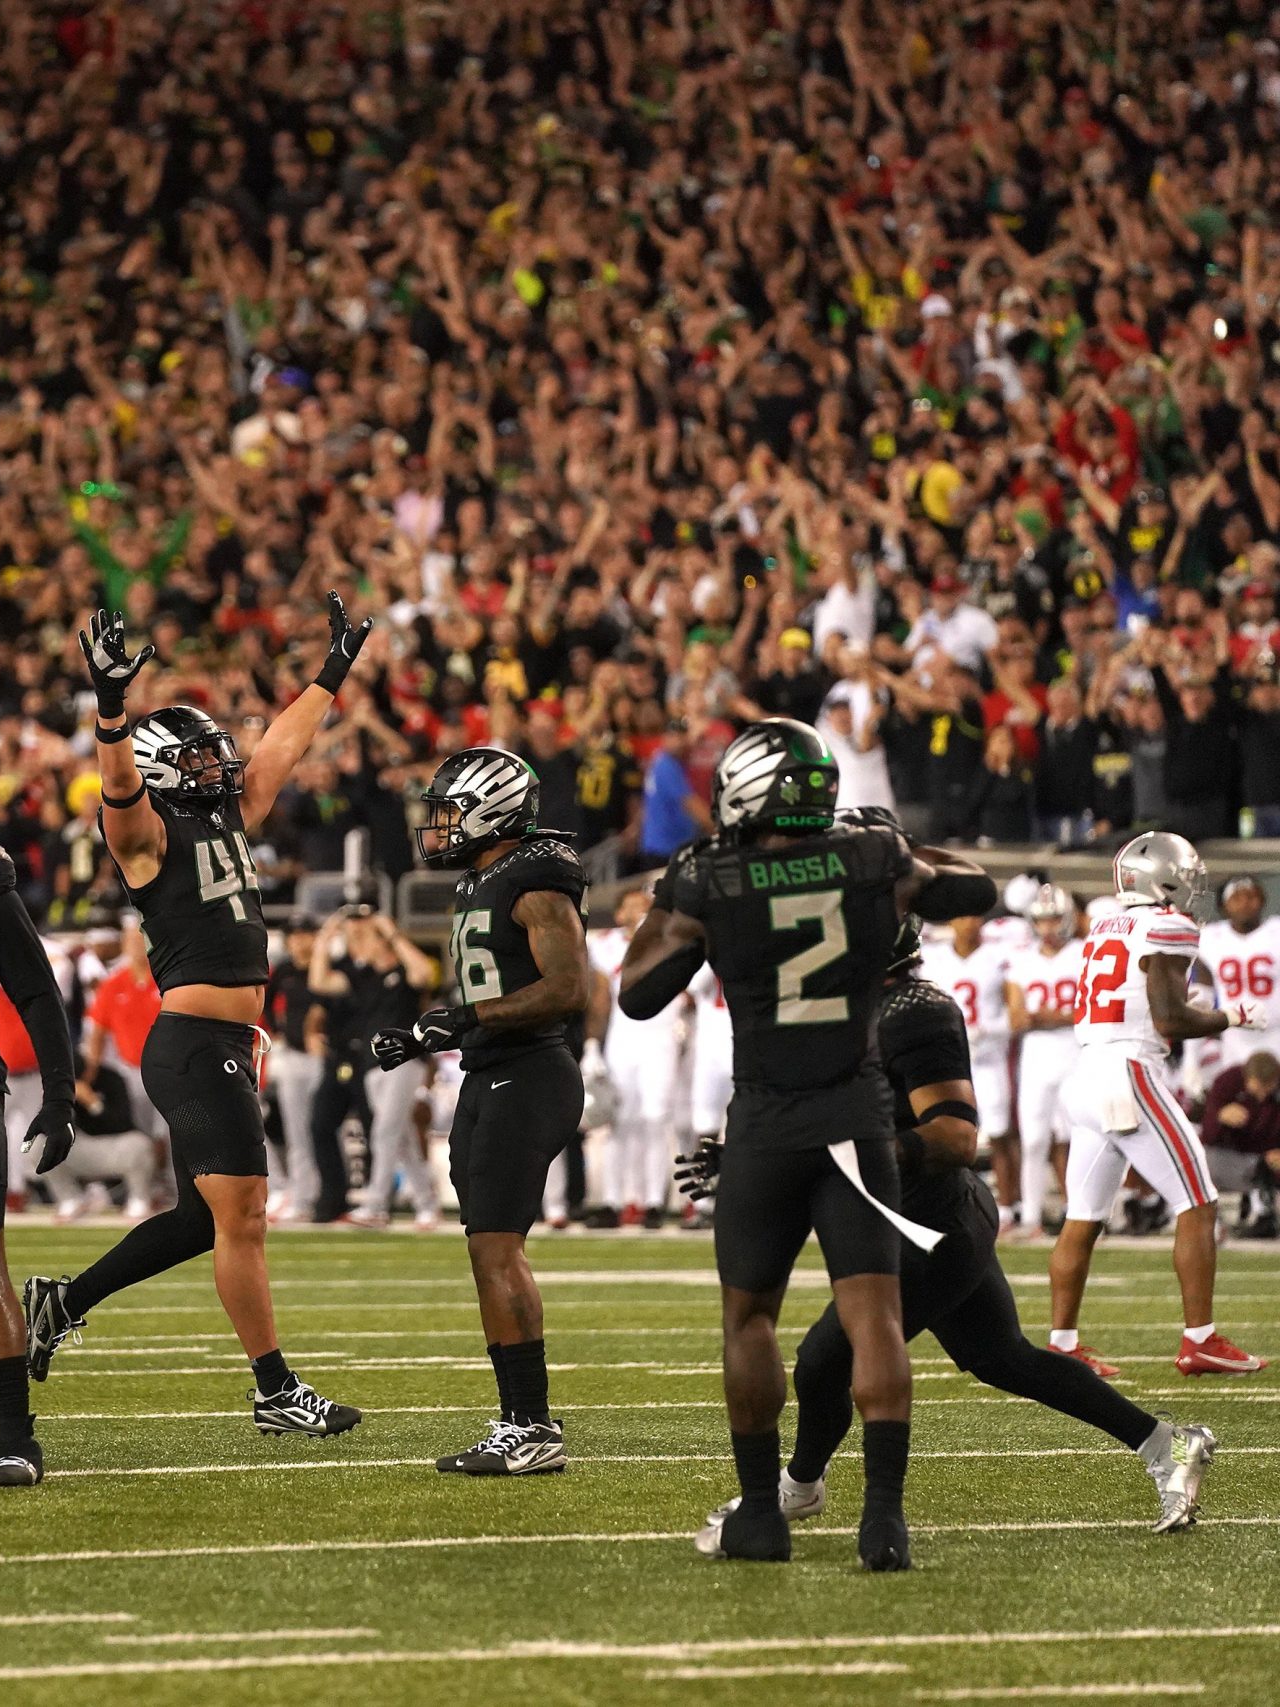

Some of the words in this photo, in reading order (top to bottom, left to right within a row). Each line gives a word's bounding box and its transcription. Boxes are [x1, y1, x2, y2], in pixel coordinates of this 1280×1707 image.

[748, 852, 848, 889] BASSA
[769, 888, 851, 1025] 2
[1218, 955, 1274, 1000] 96
[223, 1059, 238, 1074] O
